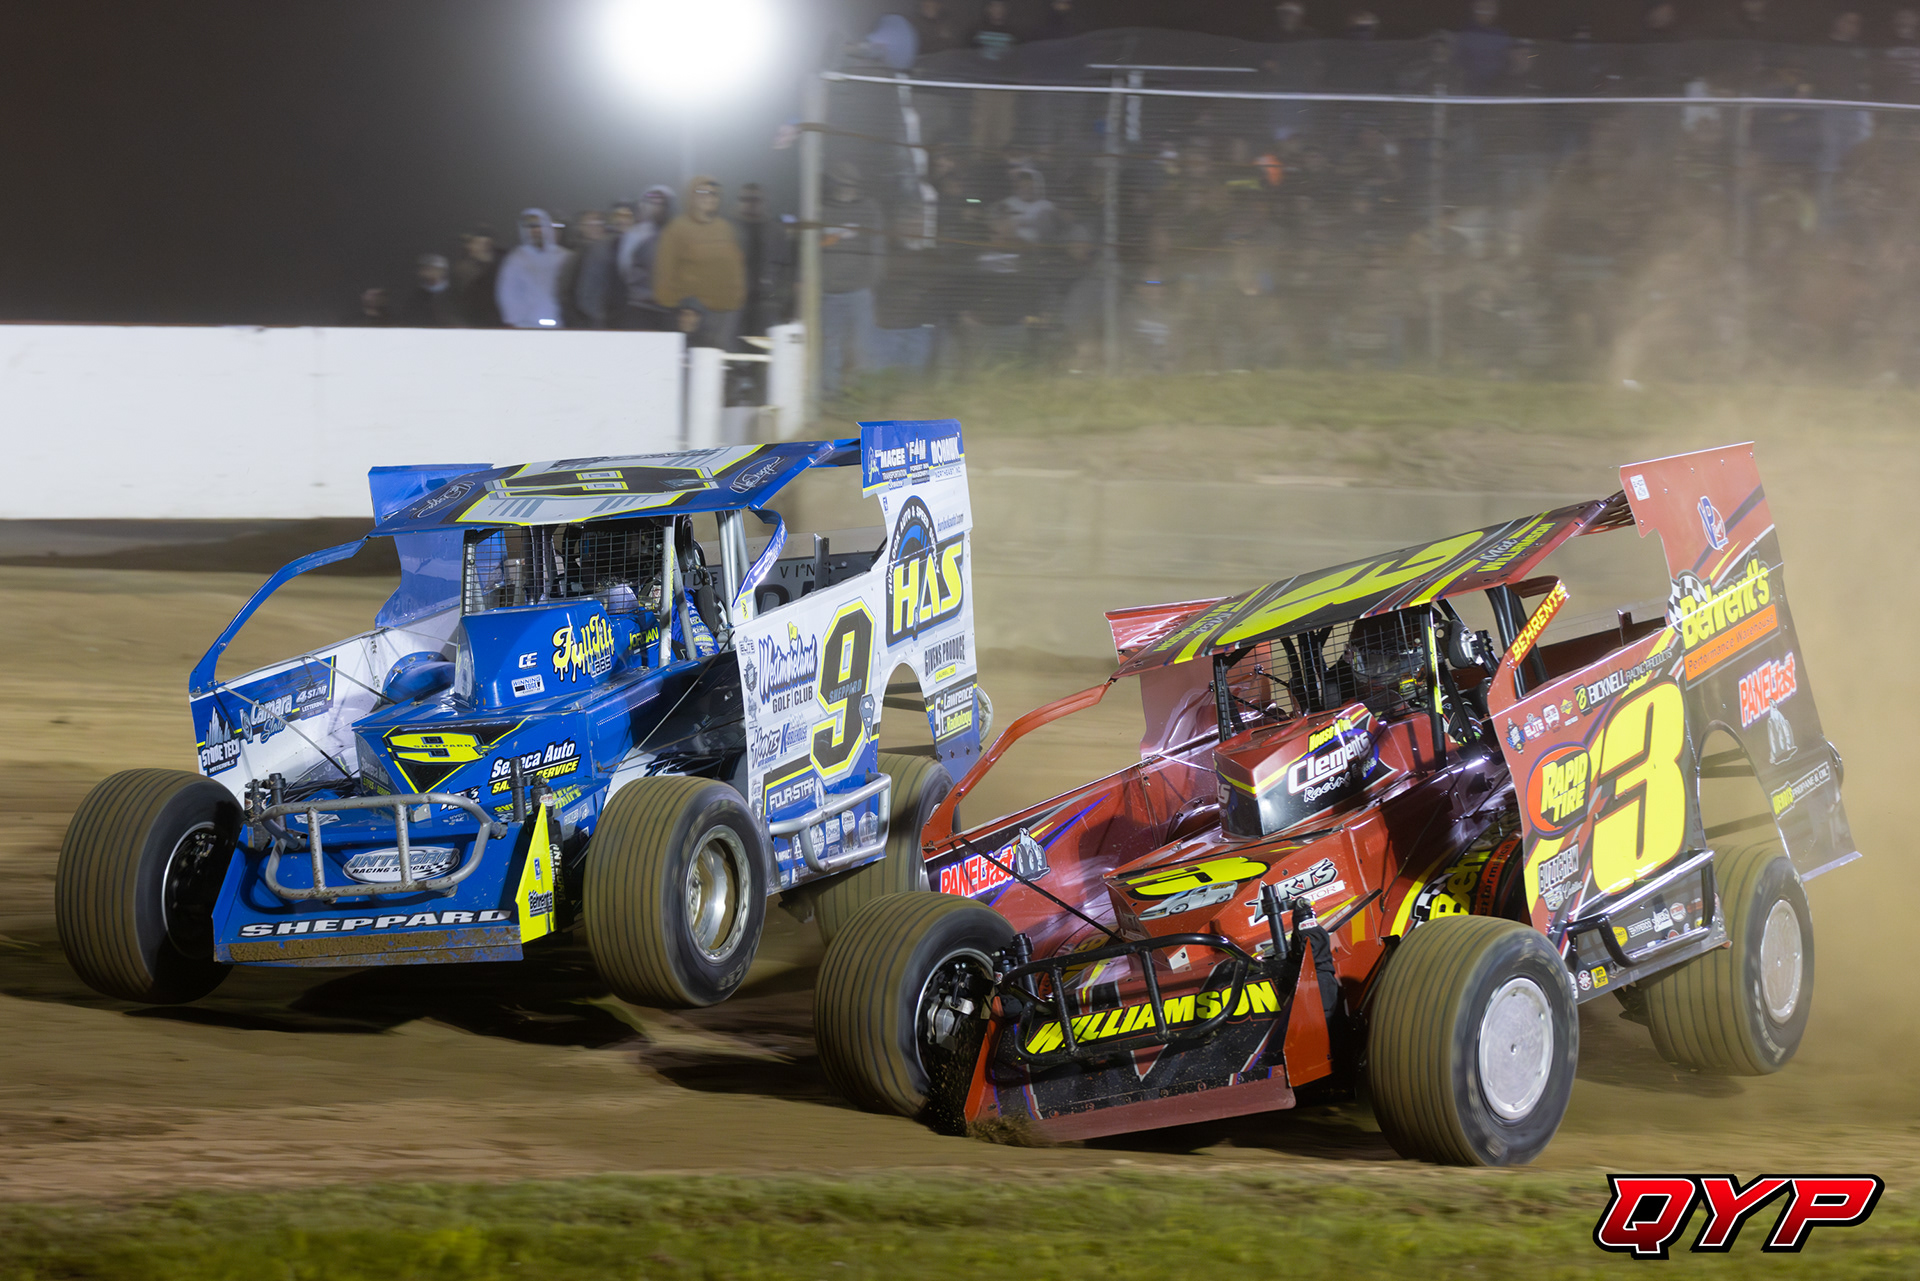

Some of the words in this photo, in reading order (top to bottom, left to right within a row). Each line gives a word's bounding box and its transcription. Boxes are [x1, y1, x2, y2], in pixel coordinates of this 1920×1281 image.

[772, 693, 791, 714] GOLF
[794, 686, 813, 706] CLUB
[812, 600, 875, 778] 9
[829, 679, 862, 703] SHEPPARD
[944, 686, 973, 710] Lawrence
[1587, 669, 1628, 704] BICKNELL
[251, 694, 292, 725] Camara
[543, 742, 576, 765] Auto
[1287, 731, 1371, 795] Clements
[1541, 751, 1588, 814] RAPID
[1592, 683, 1686, 894] 3
[1553, 784, 1587, 822] TIRE
[241, 910, 512, 937] SHEPPARD
[1025, 981, 1282, 1055] WILLIAMSON
